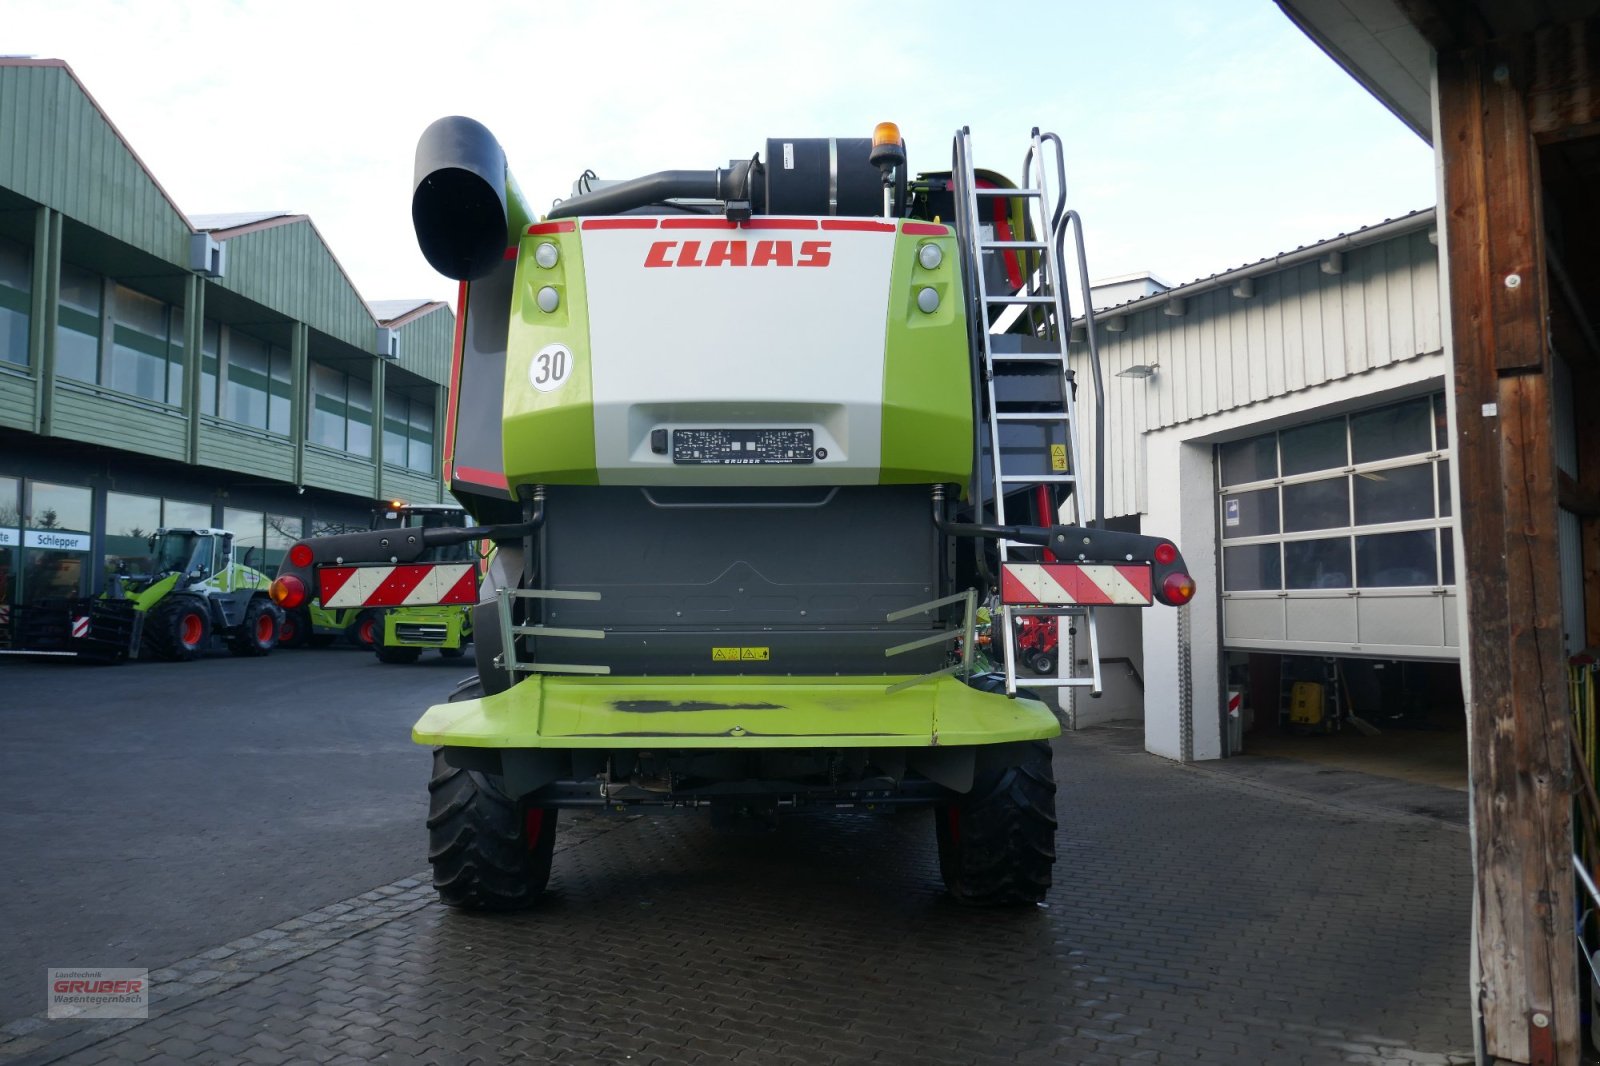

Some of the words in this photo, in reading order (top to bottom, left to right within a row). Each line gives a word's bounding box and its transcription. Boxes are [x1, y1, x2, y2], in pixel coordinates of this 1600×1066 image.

[643, 240, 832, 268] CLAAS
[535, 350, 566, 385] 30
[37, 534, 79, 549] Schlepper
